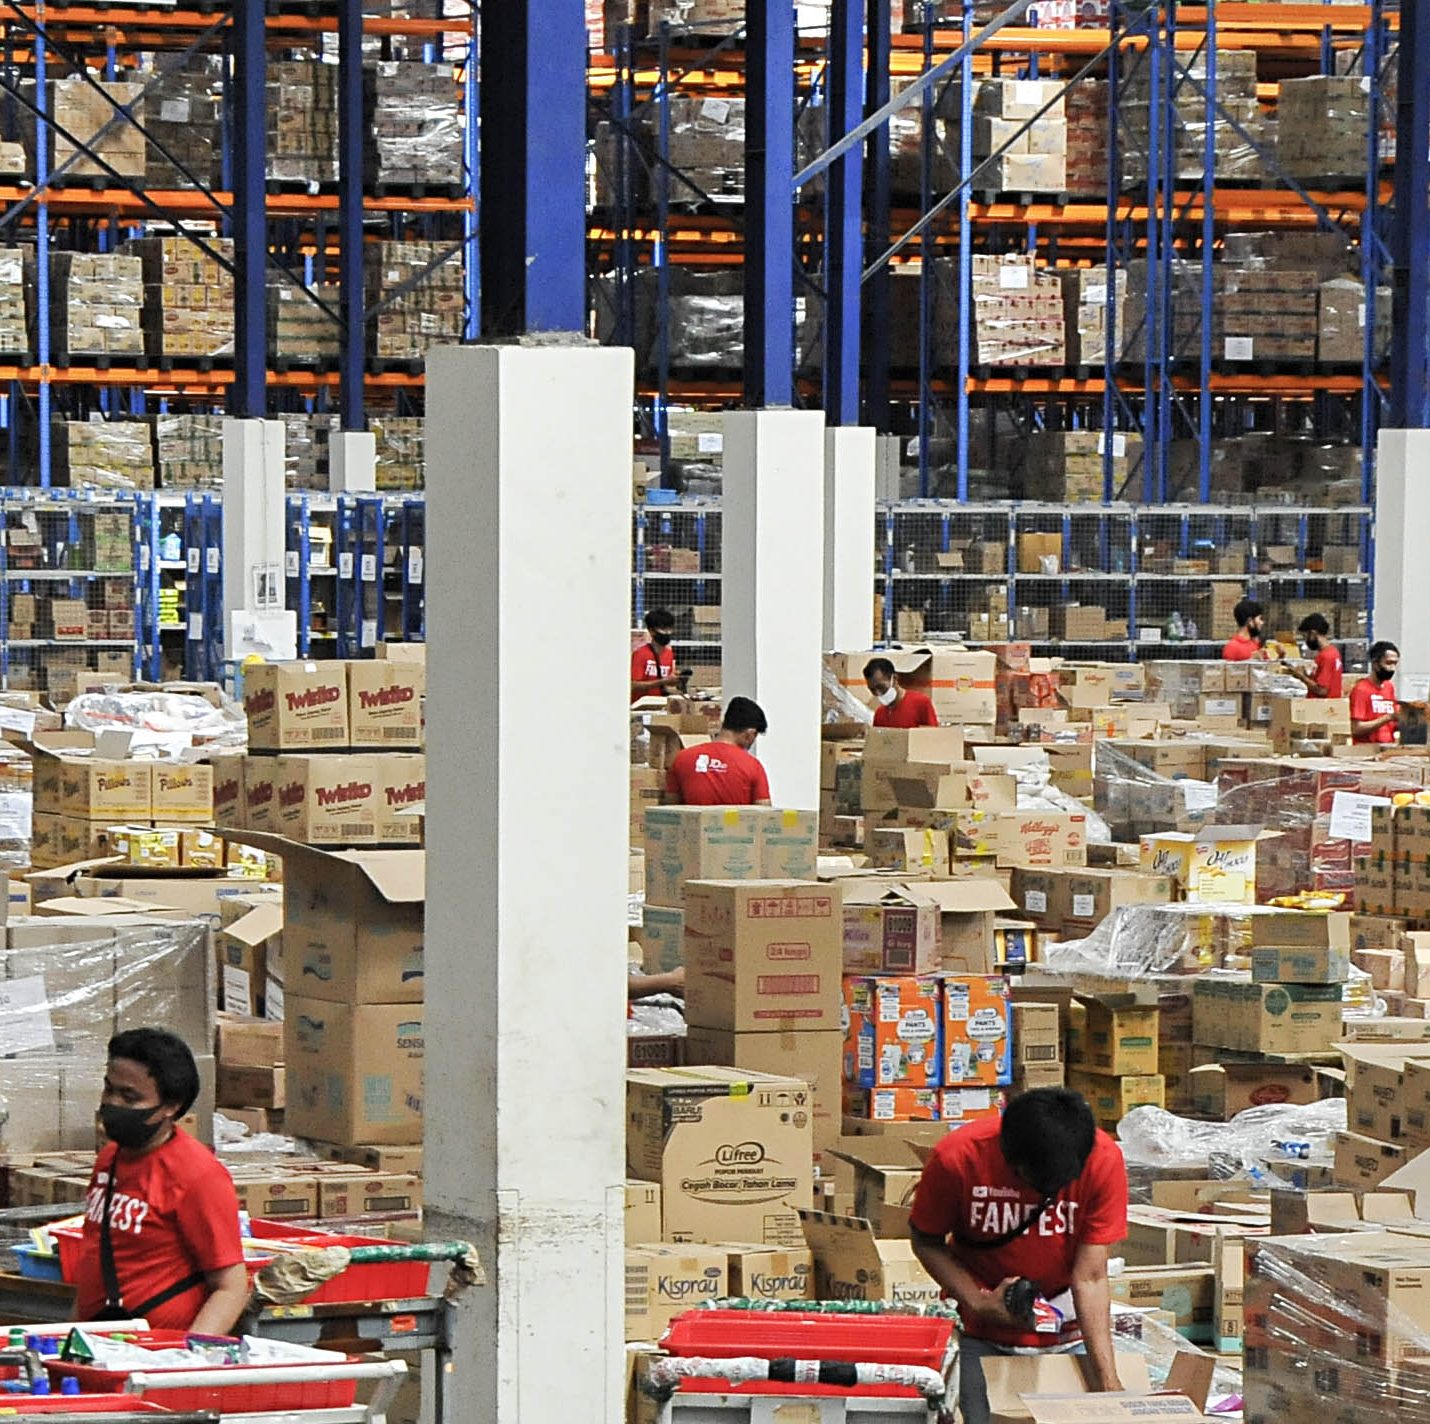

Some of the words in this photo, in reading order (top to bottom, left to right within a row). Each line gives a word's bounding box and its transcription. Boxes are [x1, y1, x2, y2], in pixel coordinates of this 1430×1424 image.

[1020, 822, 1059, 834] Kellogg's
[722, 1149, 758, 1161] Lifree
[658, 1275, 719, 1299] Kispray
[751, 1273, 808, 1298] Kispray
